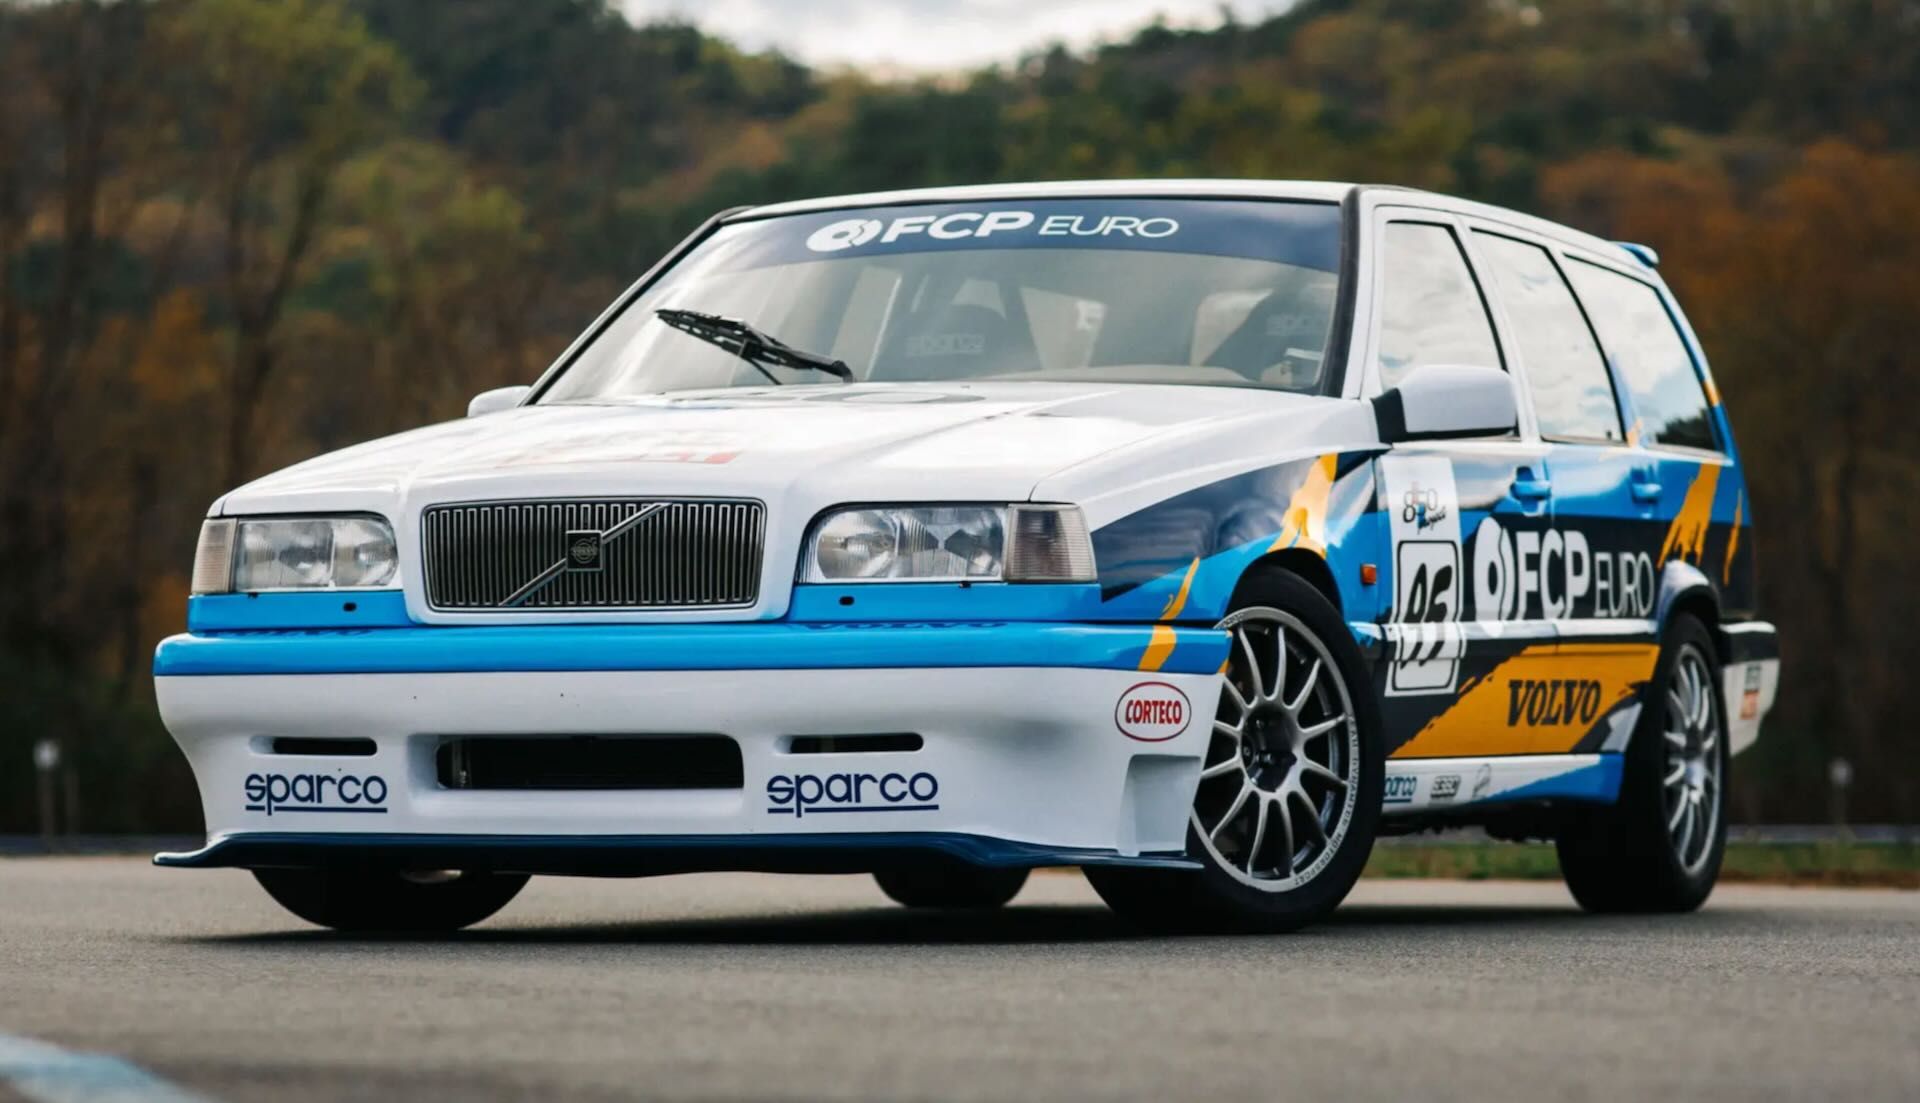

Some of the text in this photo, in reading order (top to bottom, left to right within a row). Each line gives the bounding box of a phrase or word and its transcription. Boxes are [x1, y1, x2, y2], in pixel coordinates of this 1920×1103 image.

[881, 211, 1180, 243] FCP EURO
[1515, 529, 1655, 621] FCP EURO
[1125, 699, 1182, 725] CORTECO
[1507, 679, 1602, 727] VOLVO
[245, 772, 388, 815] sparco
[767, 772, 939, 817] sparco
